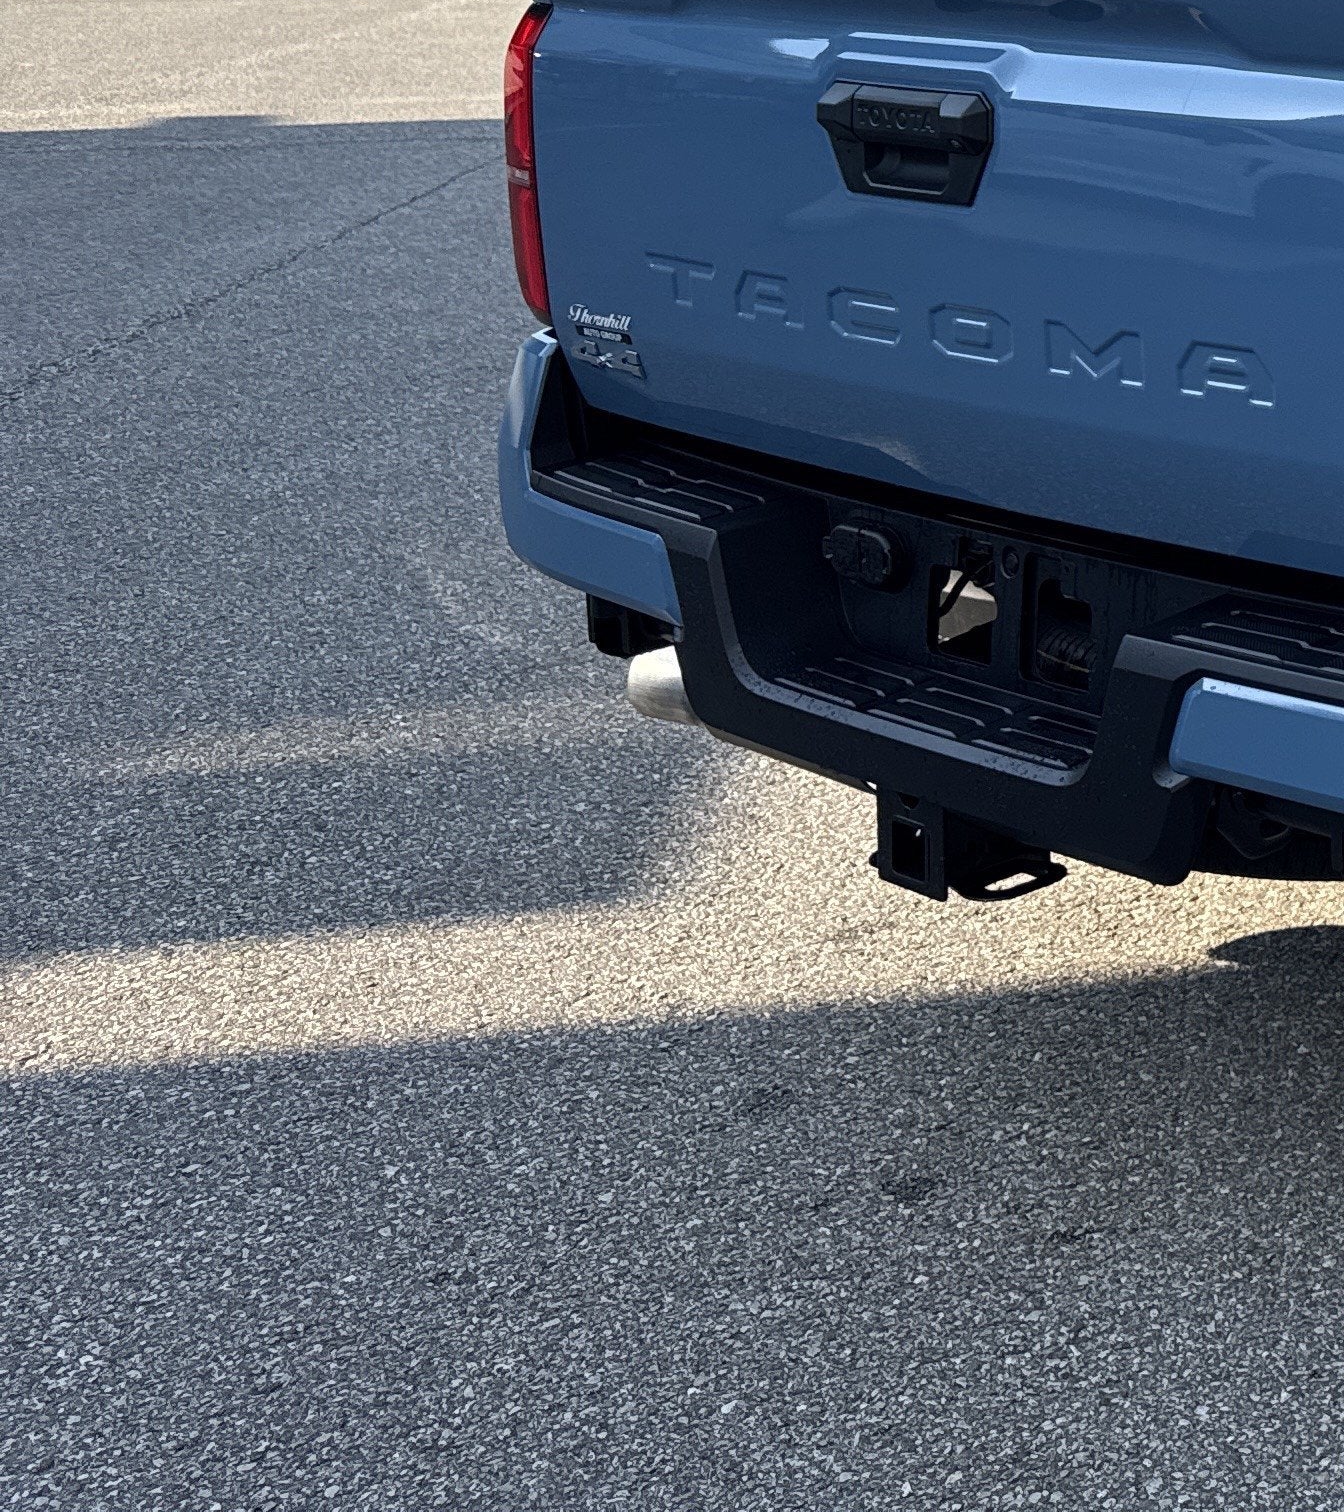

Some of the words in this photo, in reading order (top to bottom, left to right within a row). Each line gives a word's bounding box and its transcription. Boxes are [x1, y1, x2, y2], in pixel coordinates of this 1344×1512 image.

[856, 105, 937, 135] TOYOTA
[568, 303, 631, 331] Thornhill
[643, 250, 1277, 408] TACOMA
